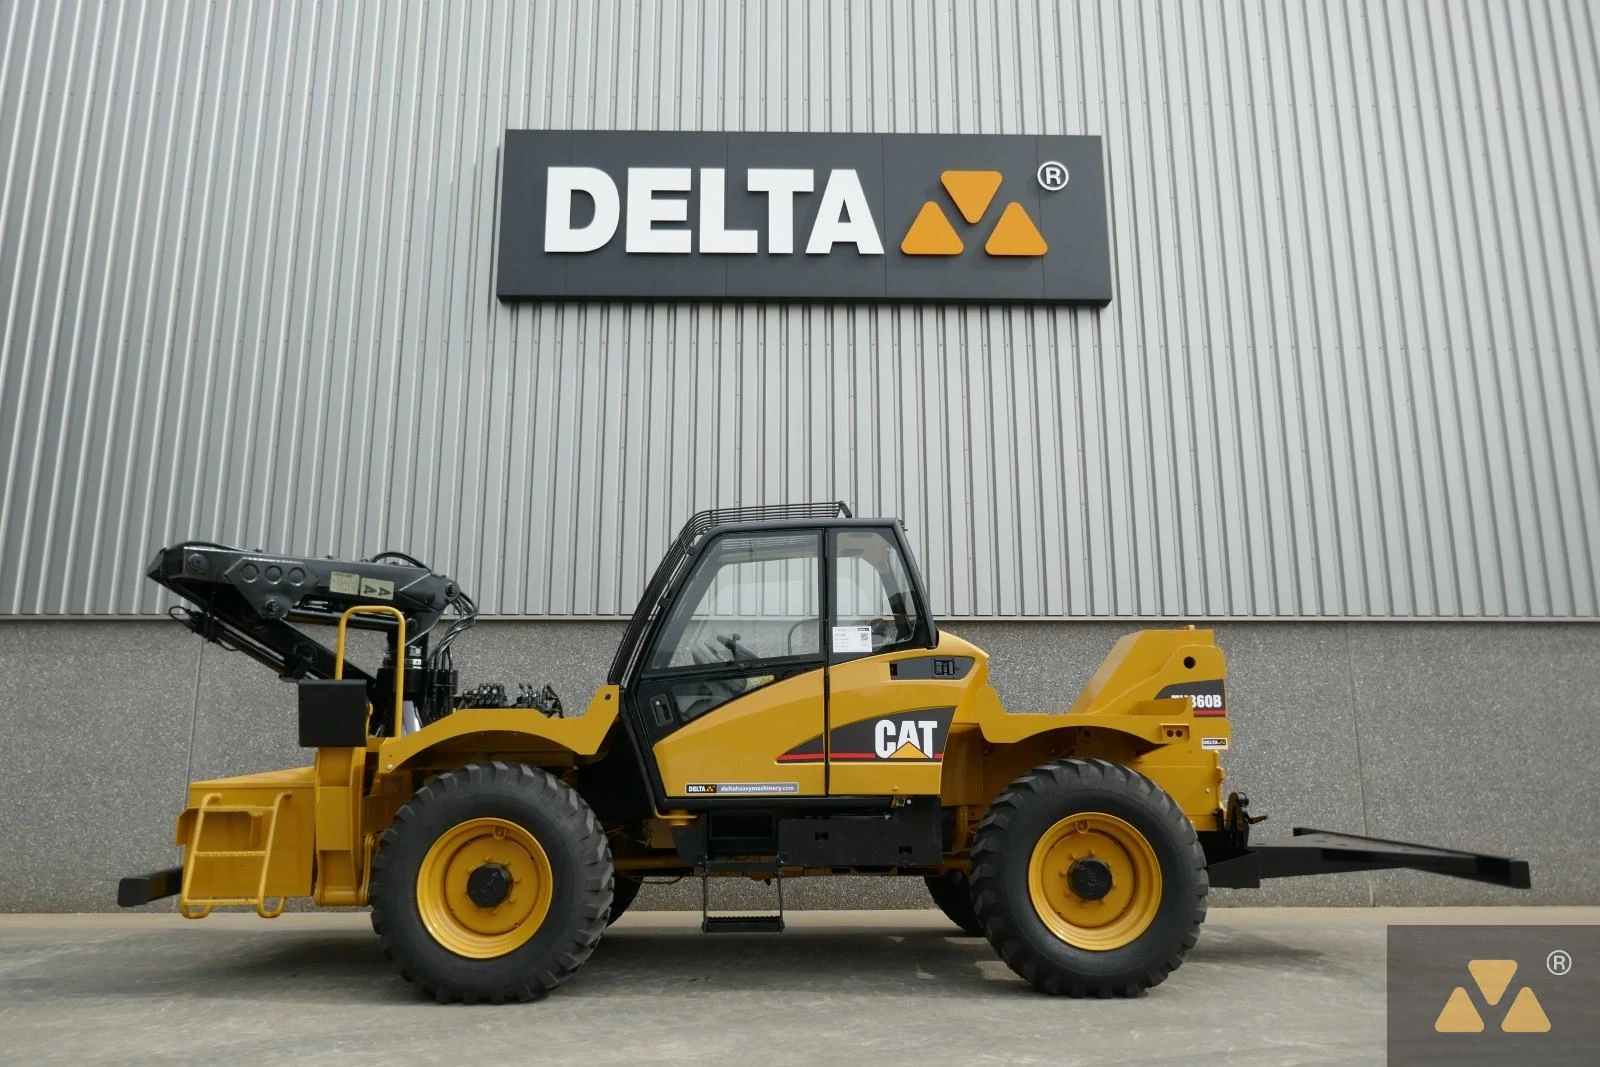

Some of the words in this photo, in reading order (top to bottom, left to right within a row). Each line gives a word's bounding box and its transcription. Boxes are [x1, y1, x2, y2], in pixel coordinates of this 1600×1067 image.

[545, 167, 884, 254] DELTA
[1171, 695, 1222, 708] 360B
[875, 719, 938, 759] CAT
